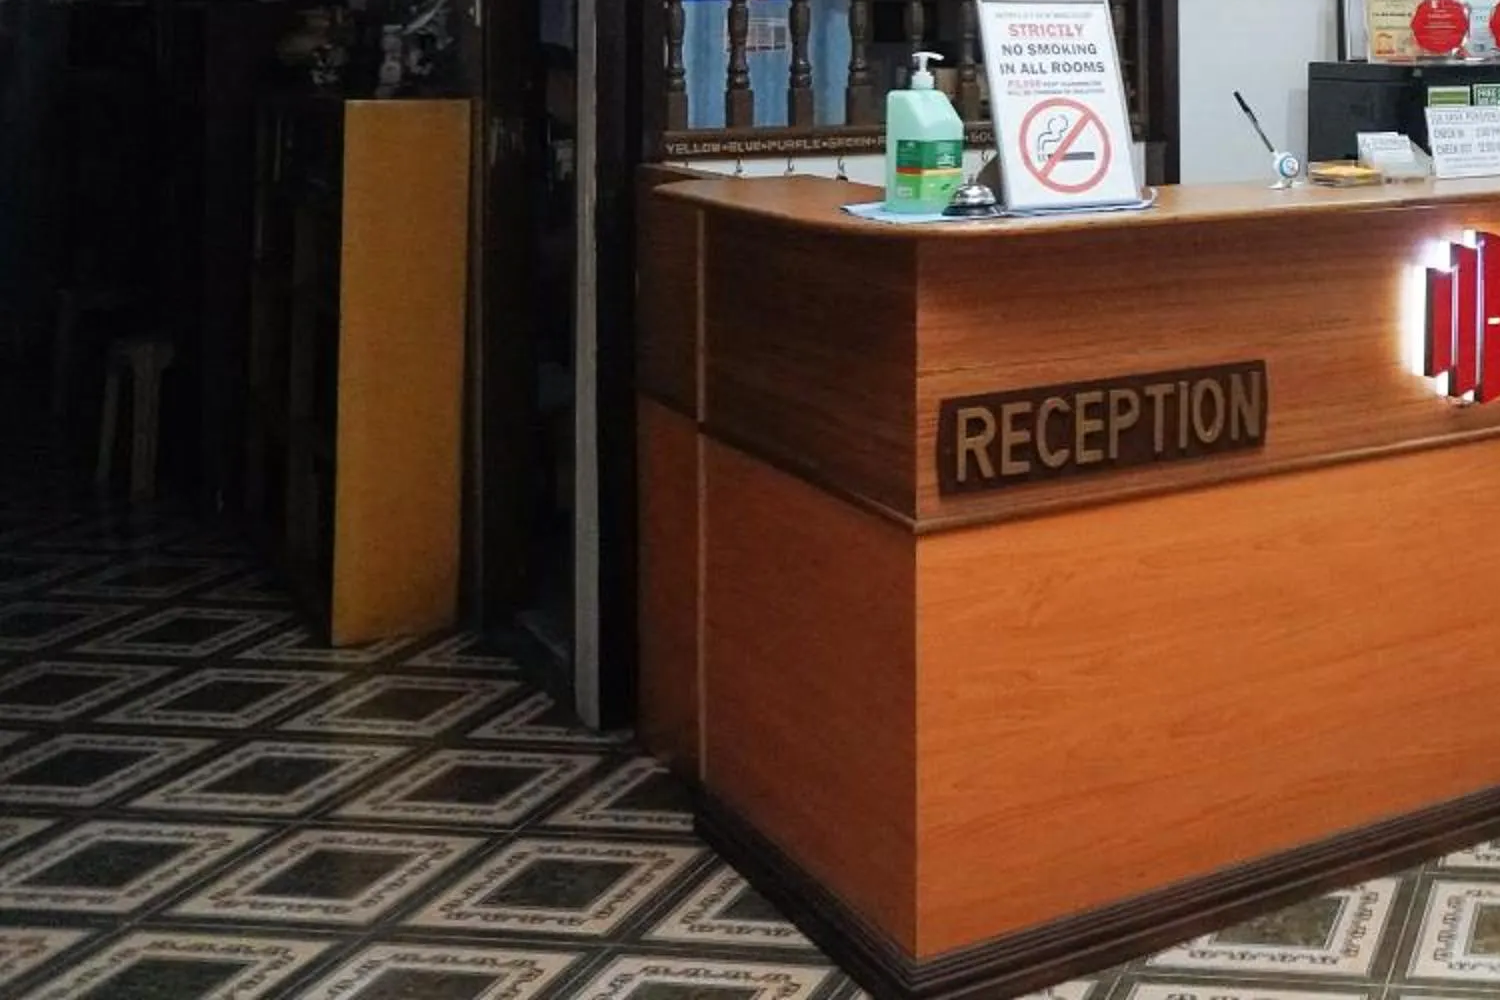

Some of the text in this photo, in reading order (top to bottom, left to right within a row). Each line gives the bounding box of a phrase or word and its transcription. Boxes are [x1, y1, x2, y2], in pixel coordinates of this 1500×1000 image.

[1007, 23, 1085, 37] STRICTLY
[1001, 43, 1097, 57] NO SMOKING
[1000, 60, 1105, 75] IN ALL ROOMS
[956, 370, 1263, 483] RECEPTION
